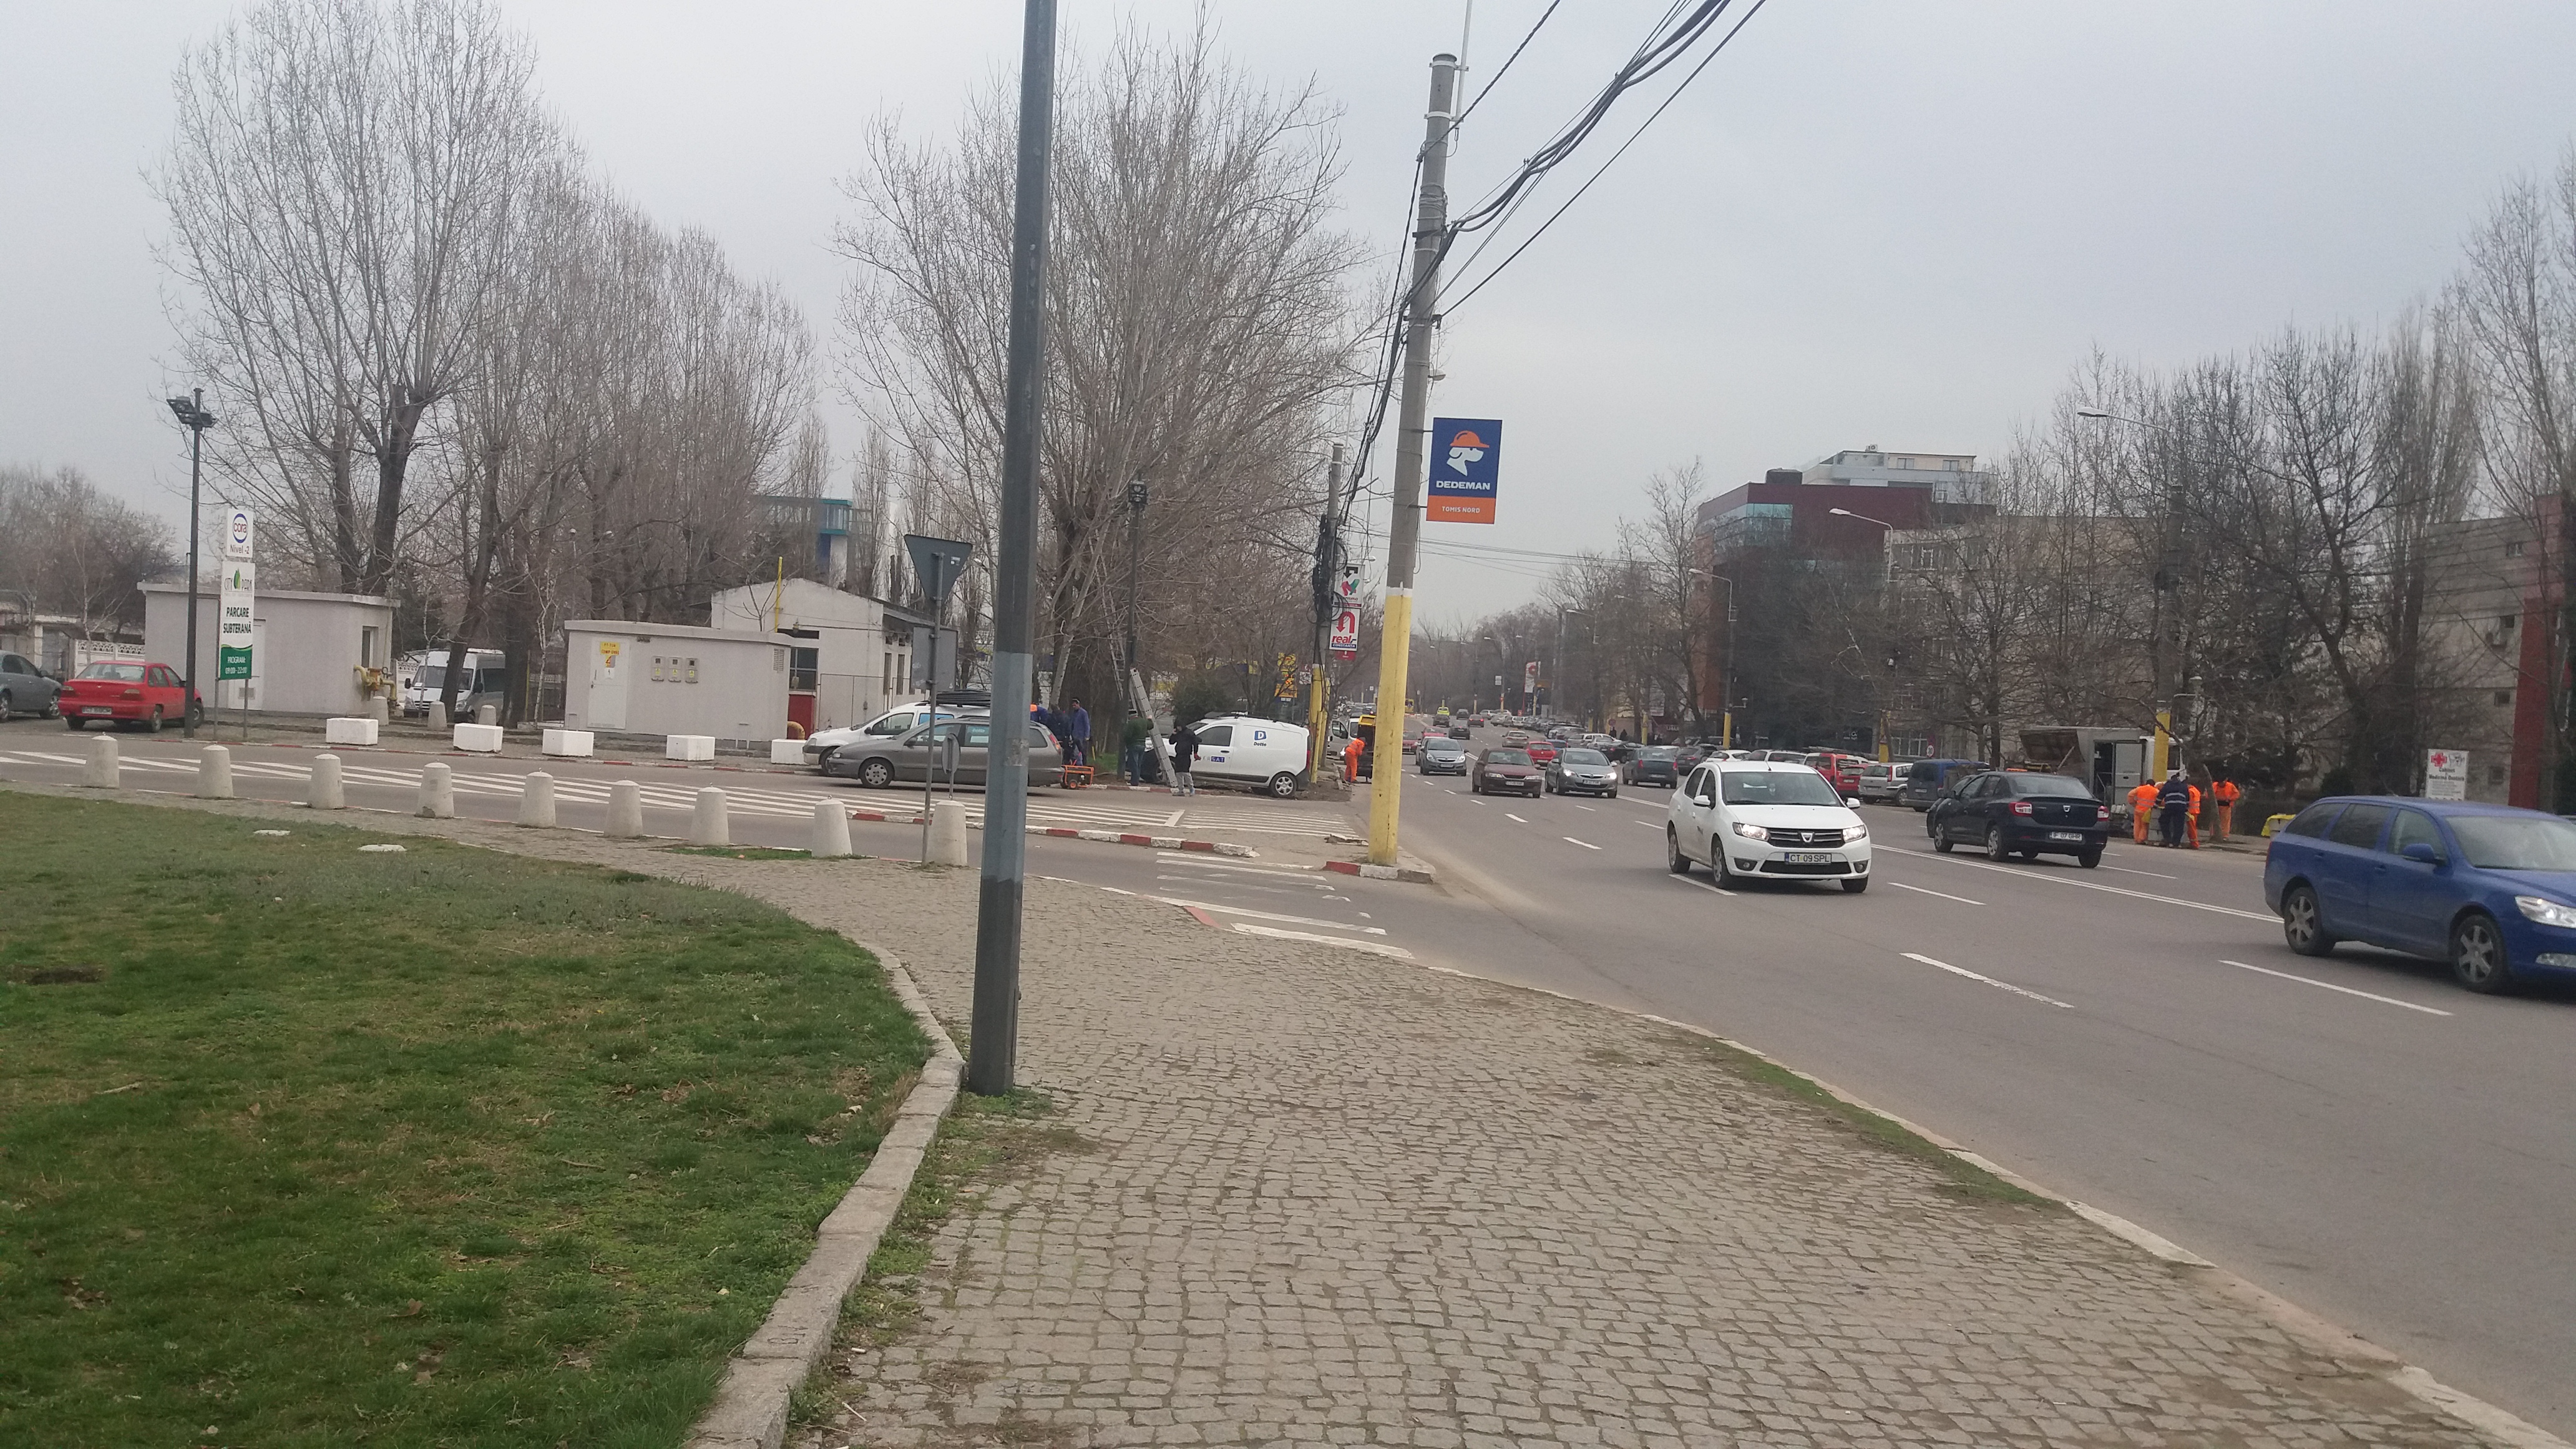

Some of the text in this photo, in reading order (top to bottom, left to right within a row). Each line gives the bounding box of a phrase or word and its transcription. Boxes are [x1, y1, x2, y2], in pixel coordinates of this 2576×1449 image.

[1436, 481, 1491, 490] DEDEMAN
[234, 523, 247, 533] cora
[230, 544, 243, 554] Nivel
[226, 607, 249, 618] PARCARE
[1803, 854, 1813, 862] 09
[1814, 854, 1830, 862] SPL
